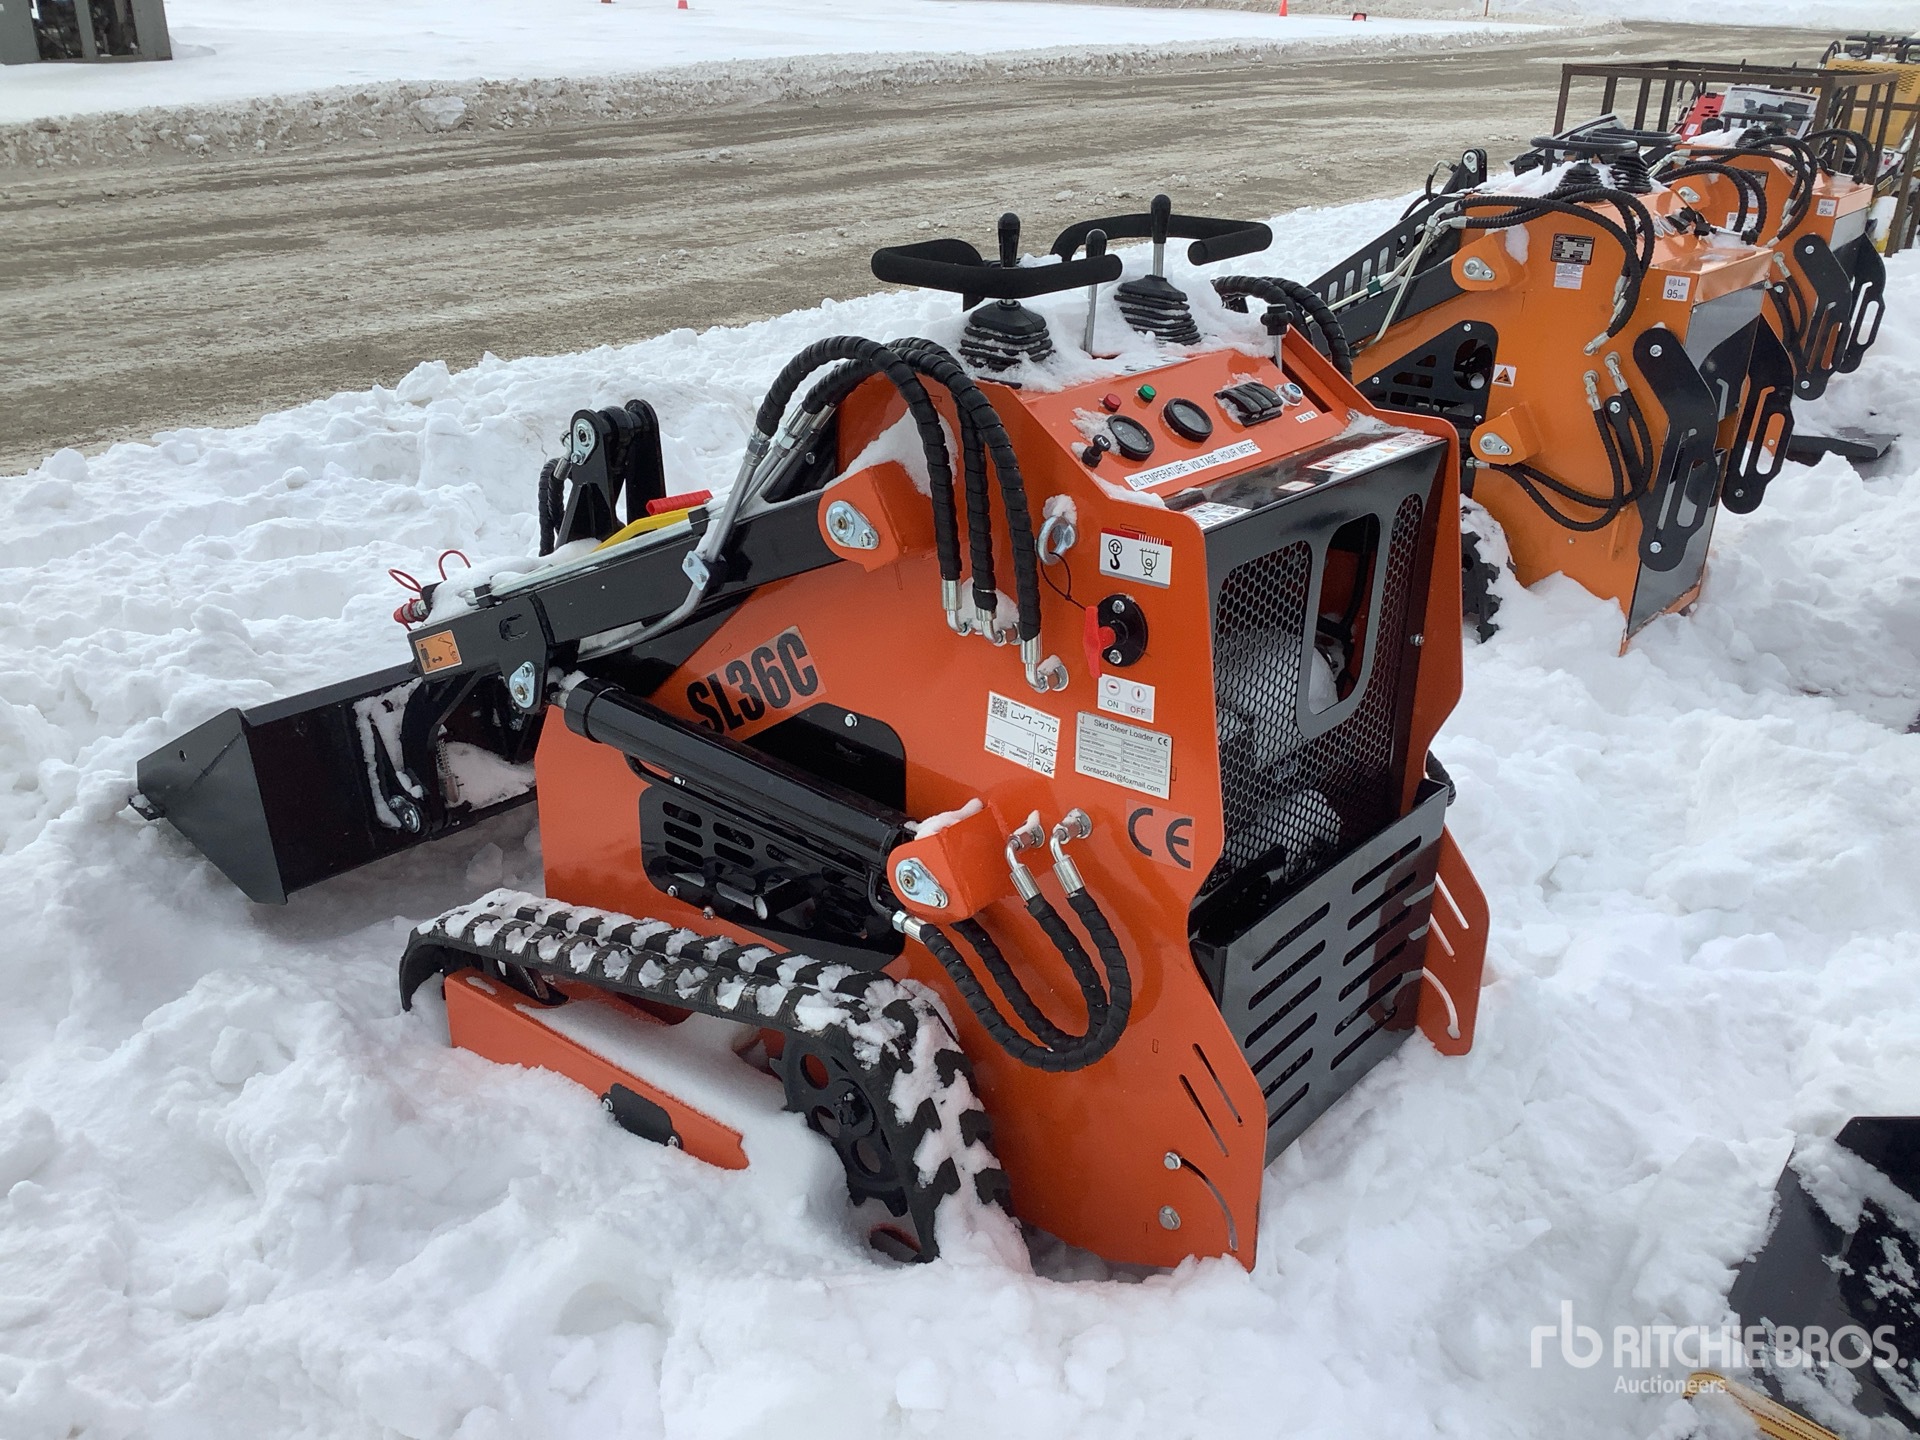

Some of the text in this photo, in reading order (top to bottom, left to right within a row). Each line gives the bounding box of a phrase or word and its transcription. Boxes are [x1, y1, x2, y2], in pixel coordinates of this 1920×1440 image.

[1188, 454, 1219, 470] VOLTAGE
[1218, 448, 1239, 460] HOUR
[687, 633, 818, 735] SL36C
[1107, 700, 1146, 715] ON OFF
[1094, 719, 1109, 730] Skid
[1110, 724, 1128, 735] Steer
[1129, 729, 1154, 742] Loader
[1158, 737, 1168, 747] CE
[1083, 764, 1161, 793] contact24h@foxmail.com
[1128, 807, 1192, 869] CE
